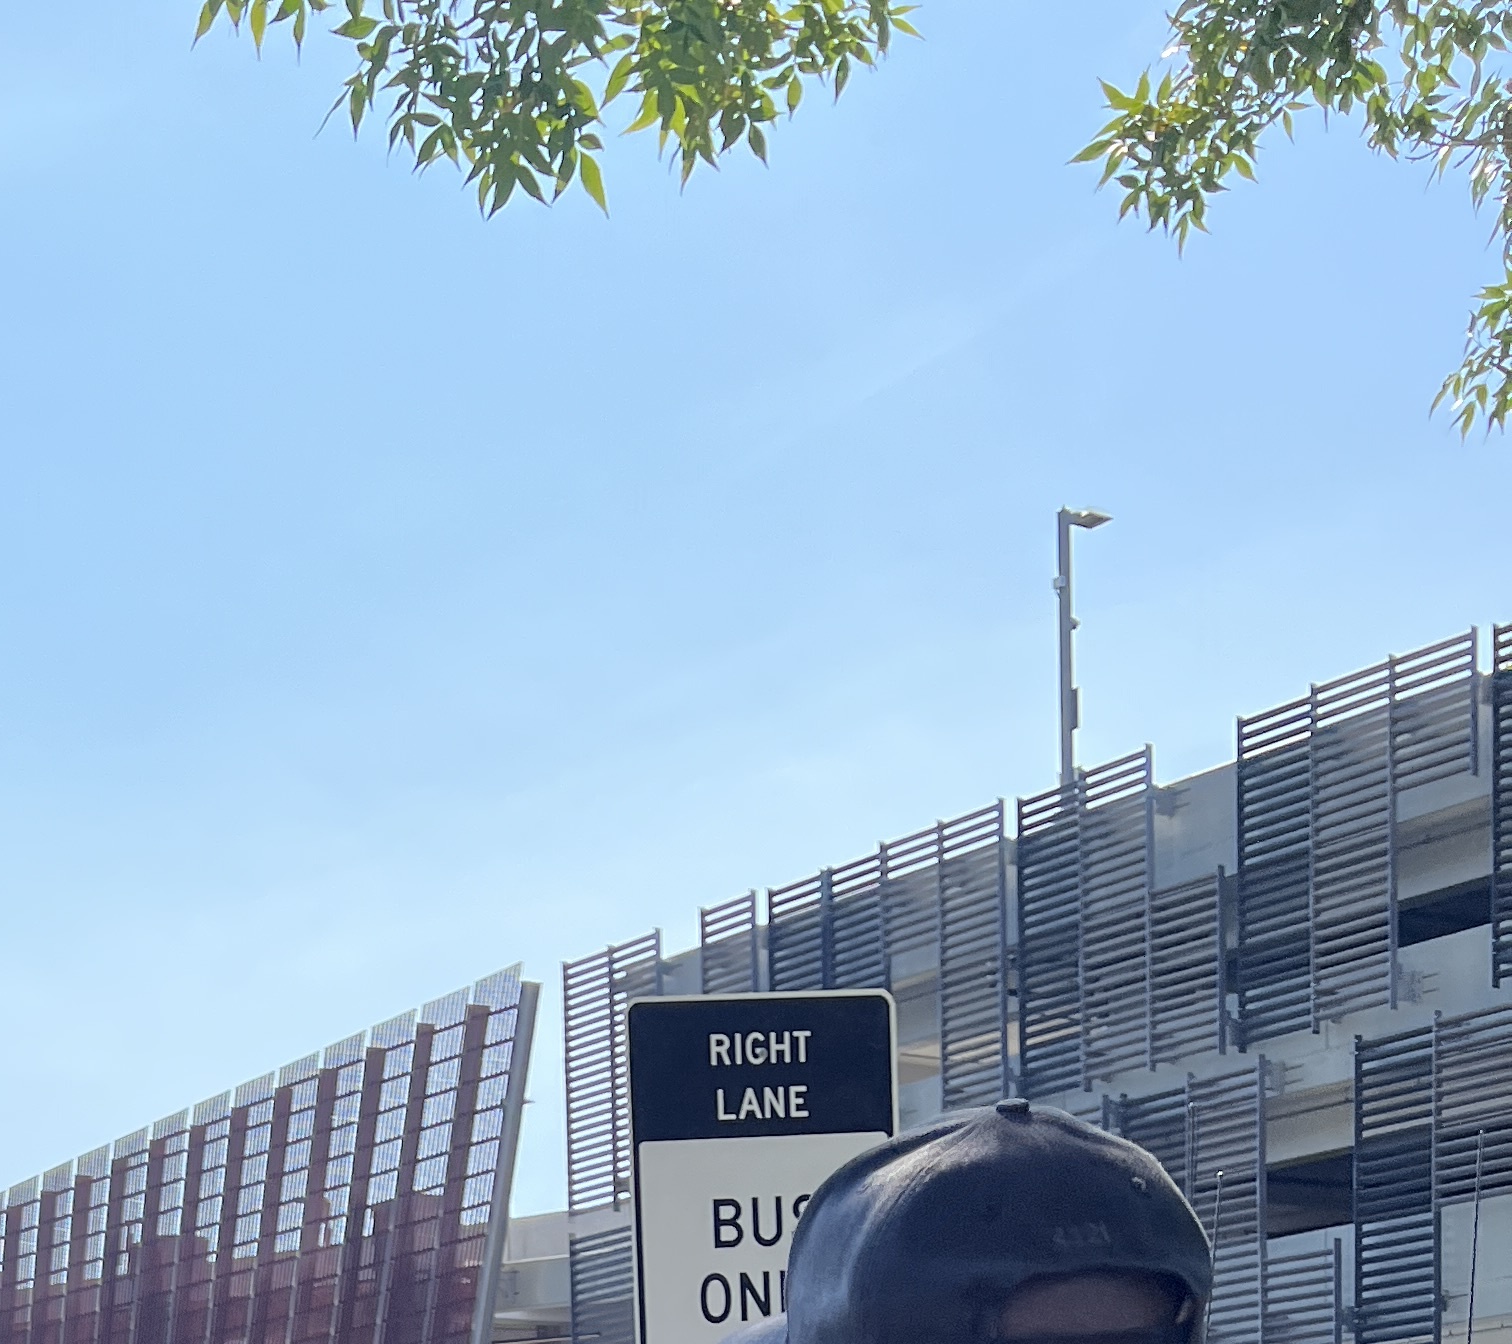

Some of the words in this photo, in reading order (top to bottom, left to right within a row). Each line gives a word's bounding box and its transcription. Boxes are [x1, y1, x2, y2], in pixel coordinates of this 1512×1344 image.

[709, 1030, 812, 1066] RIGHT
[716, 1084, 809, 1120] LANE
[700, 1269, 786, 1324] ON
